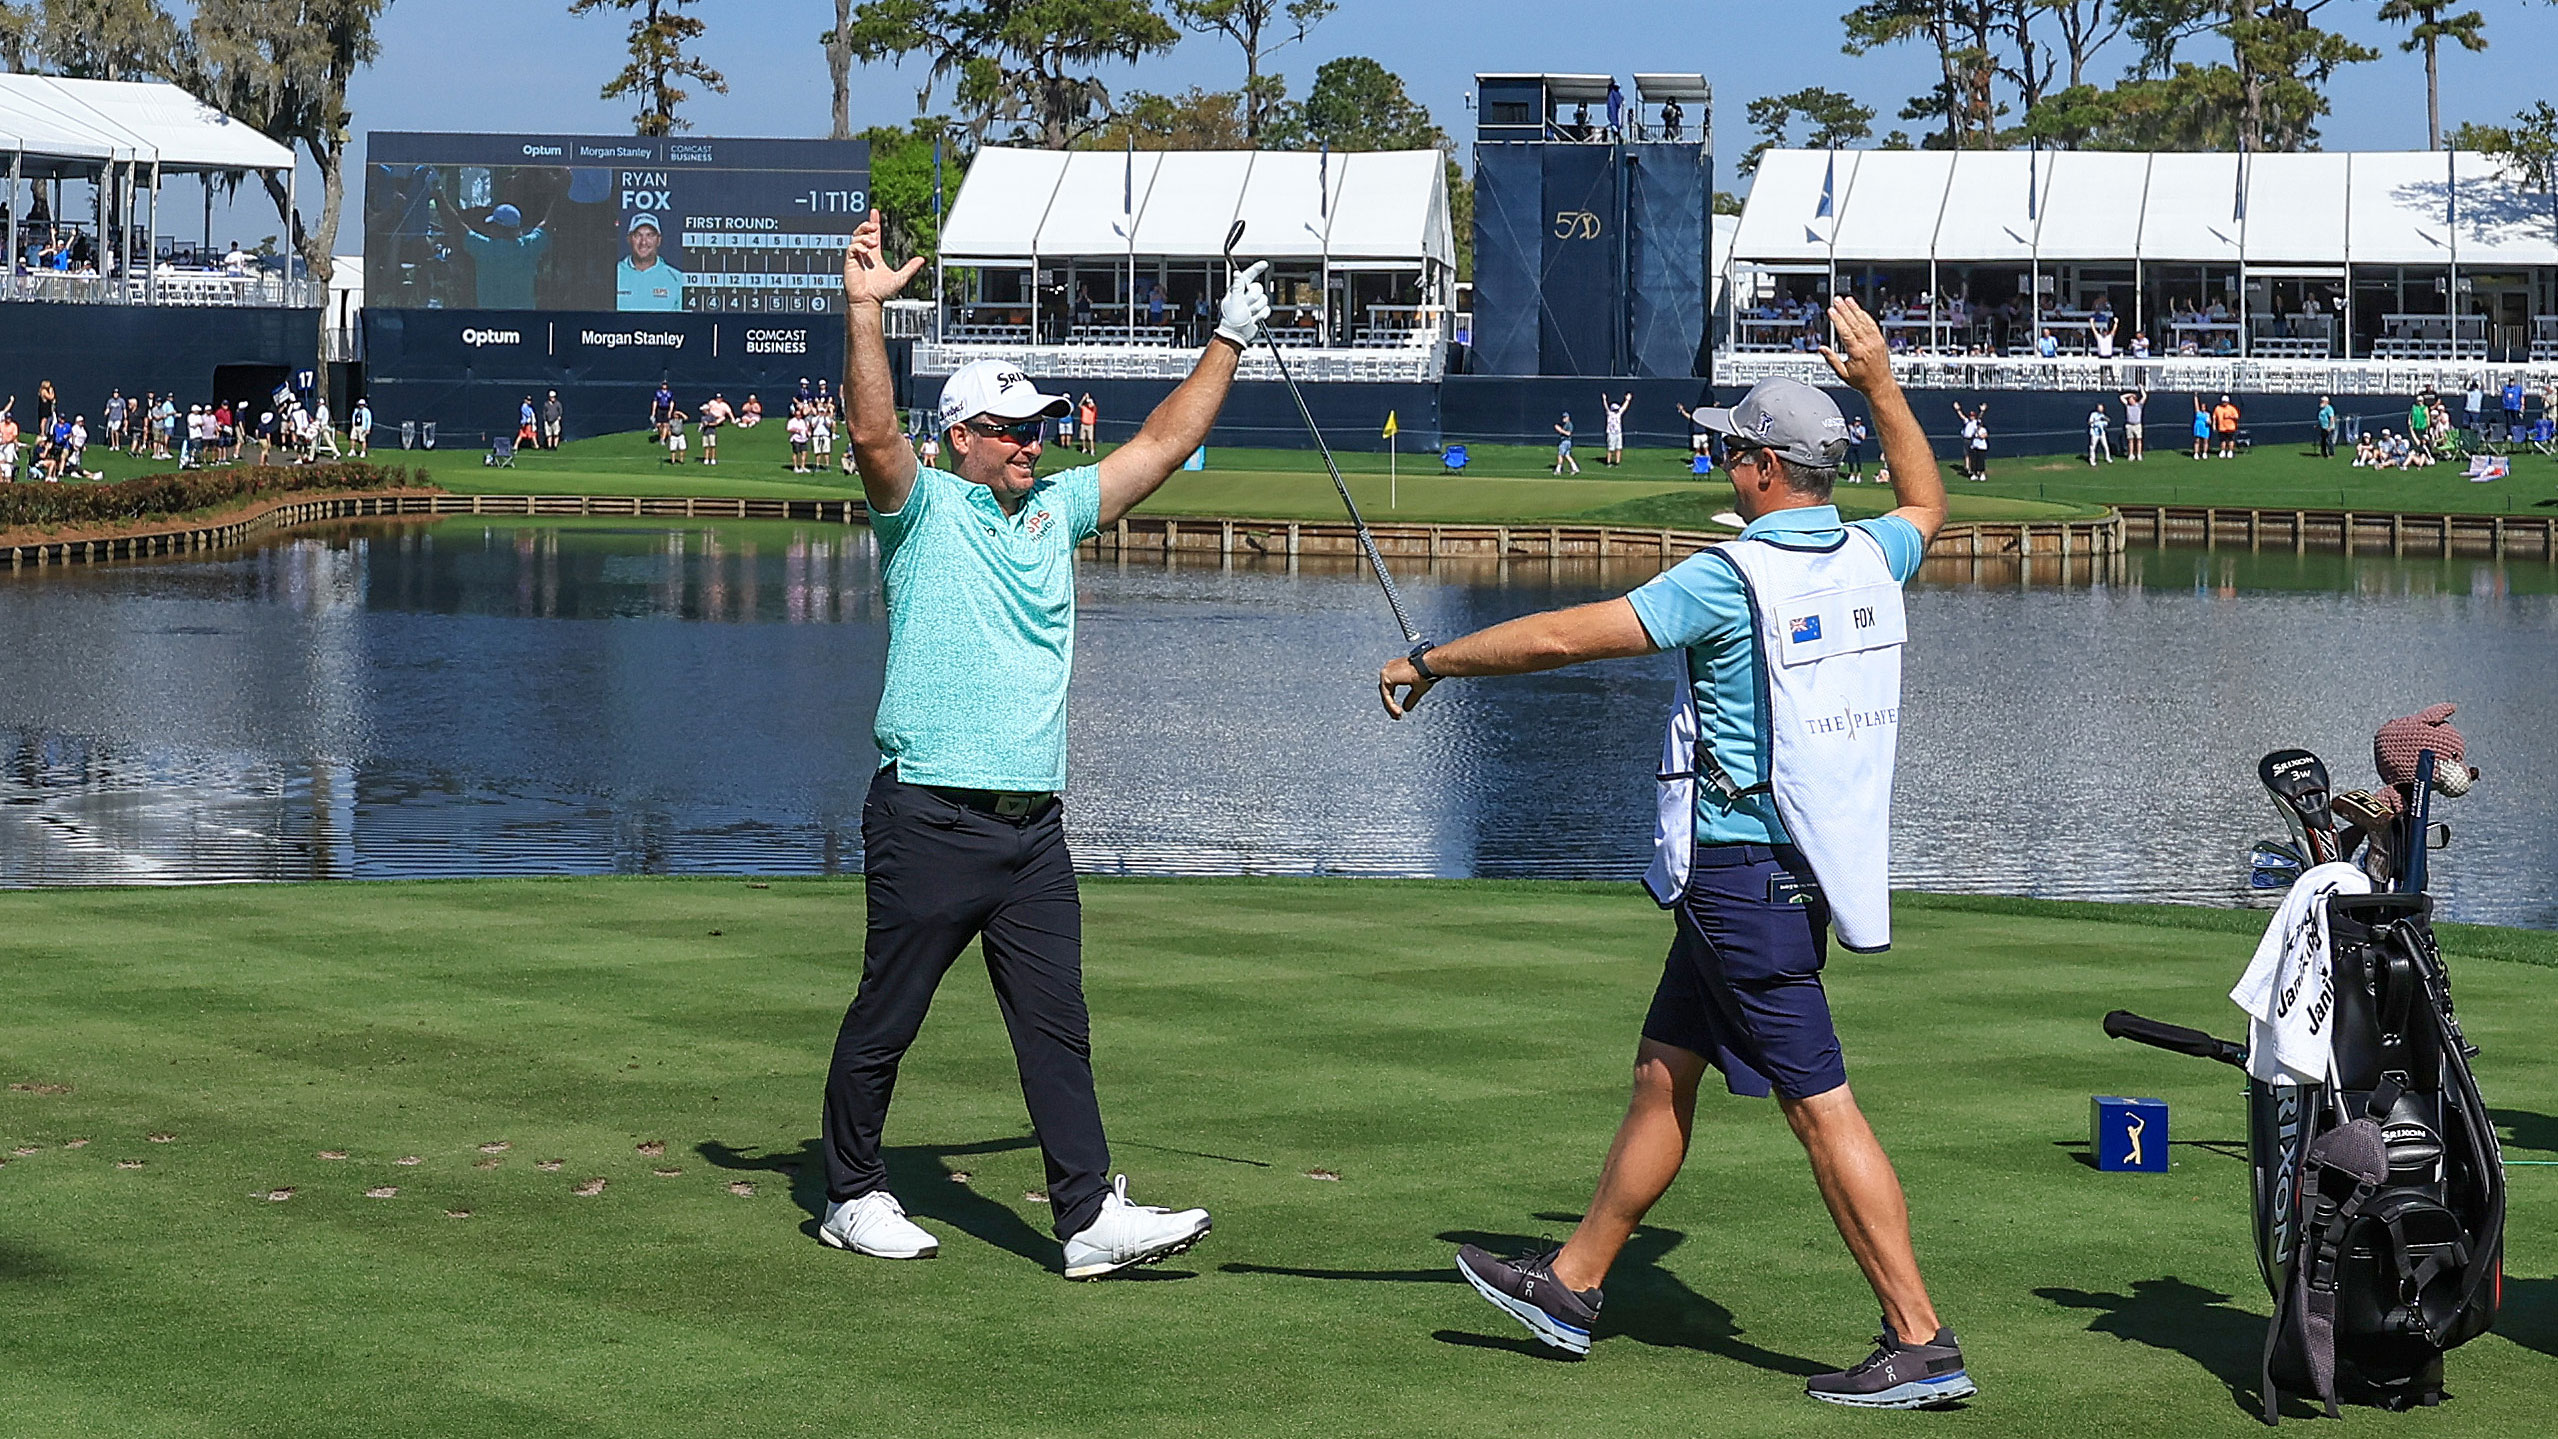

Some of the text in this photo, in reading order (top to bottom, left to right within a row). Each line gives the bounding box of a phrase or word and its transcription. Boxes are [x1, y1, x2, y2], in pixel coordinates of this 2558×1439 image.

[523, 145, 652, 159] Optum Morgan Stanley
[670, 145, 712, 153] COMCAST
[670, 153, 713, 162] BUSINESS
[622, 172, 667, 187] RYAN
[621, 191, 672, 210] FOX
[685, 217, 779, 230] FIRST ROUND:
[686, 276, 698, 284] 10
[709, 276, 718, 284] 11
[729, 276, 740, 285] 12
[750, 276, 761, 285] 13
[771, 277, 782, 286] 14
[792, 277, 803, 286] 15
[813, 277, 824, 286] 16
[688, 298, 822, 308] 4 4 4 3 5 5 3
[462, 328, 685, 349] Optum Morgan Stanley
[746, 329, 807, 341] COMCAST
[746, 342, 806, 353] BUSINESS
[299, 371, 313, 388] 17
[1853, 606, 1875, 629] FOX
[1805, 707, 1900, 734] THE PLAYE
[2272, 756, 2315, 777] SRIXON
[2381, 1129, 2426, 1143] SRIXON
[2274, 1086, 2298, 1265] RIXON
